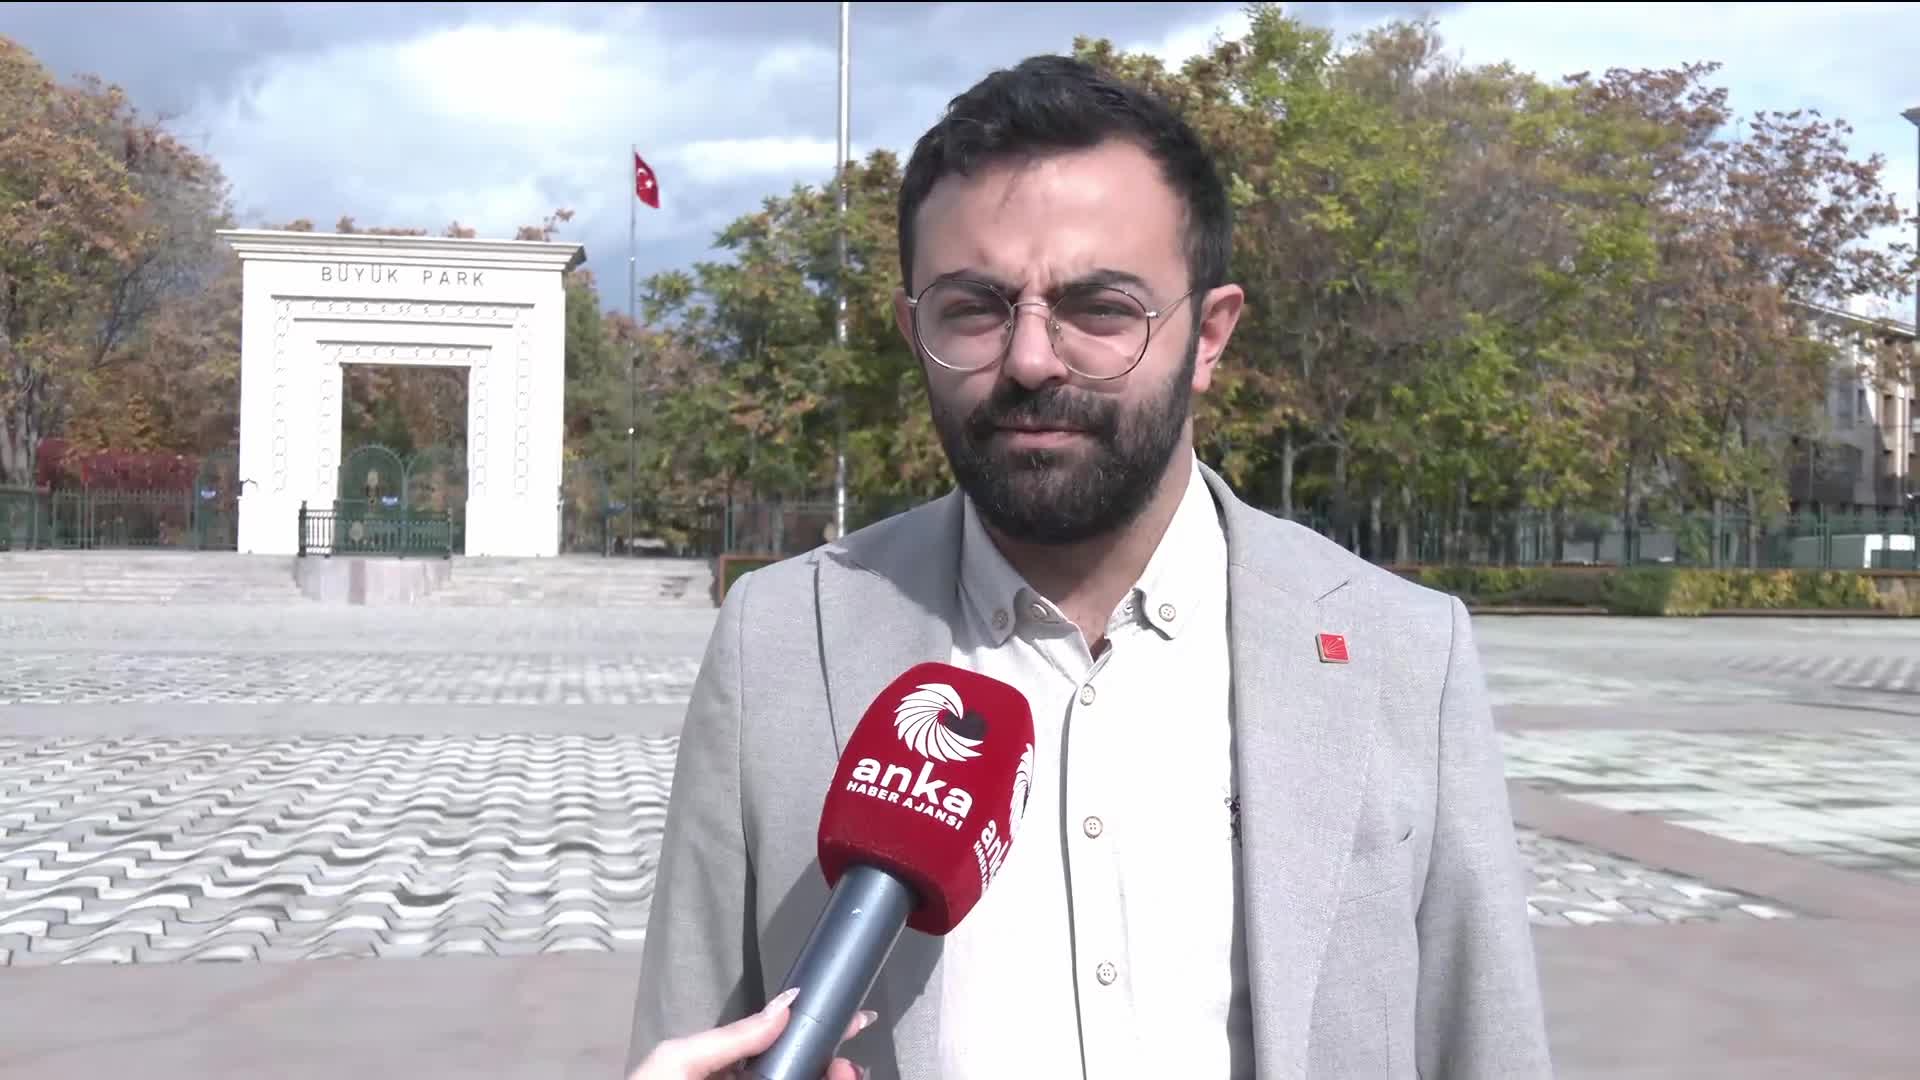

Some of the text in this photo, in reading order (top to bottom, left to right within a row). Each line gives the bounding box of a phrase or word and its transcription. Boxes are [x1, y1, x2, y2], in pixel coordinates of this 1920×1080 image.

[423, 269, 484, 286] PARK
[846, 780, 964, 831] HABER AJANSI
[852, 758, 973, 819] anka
